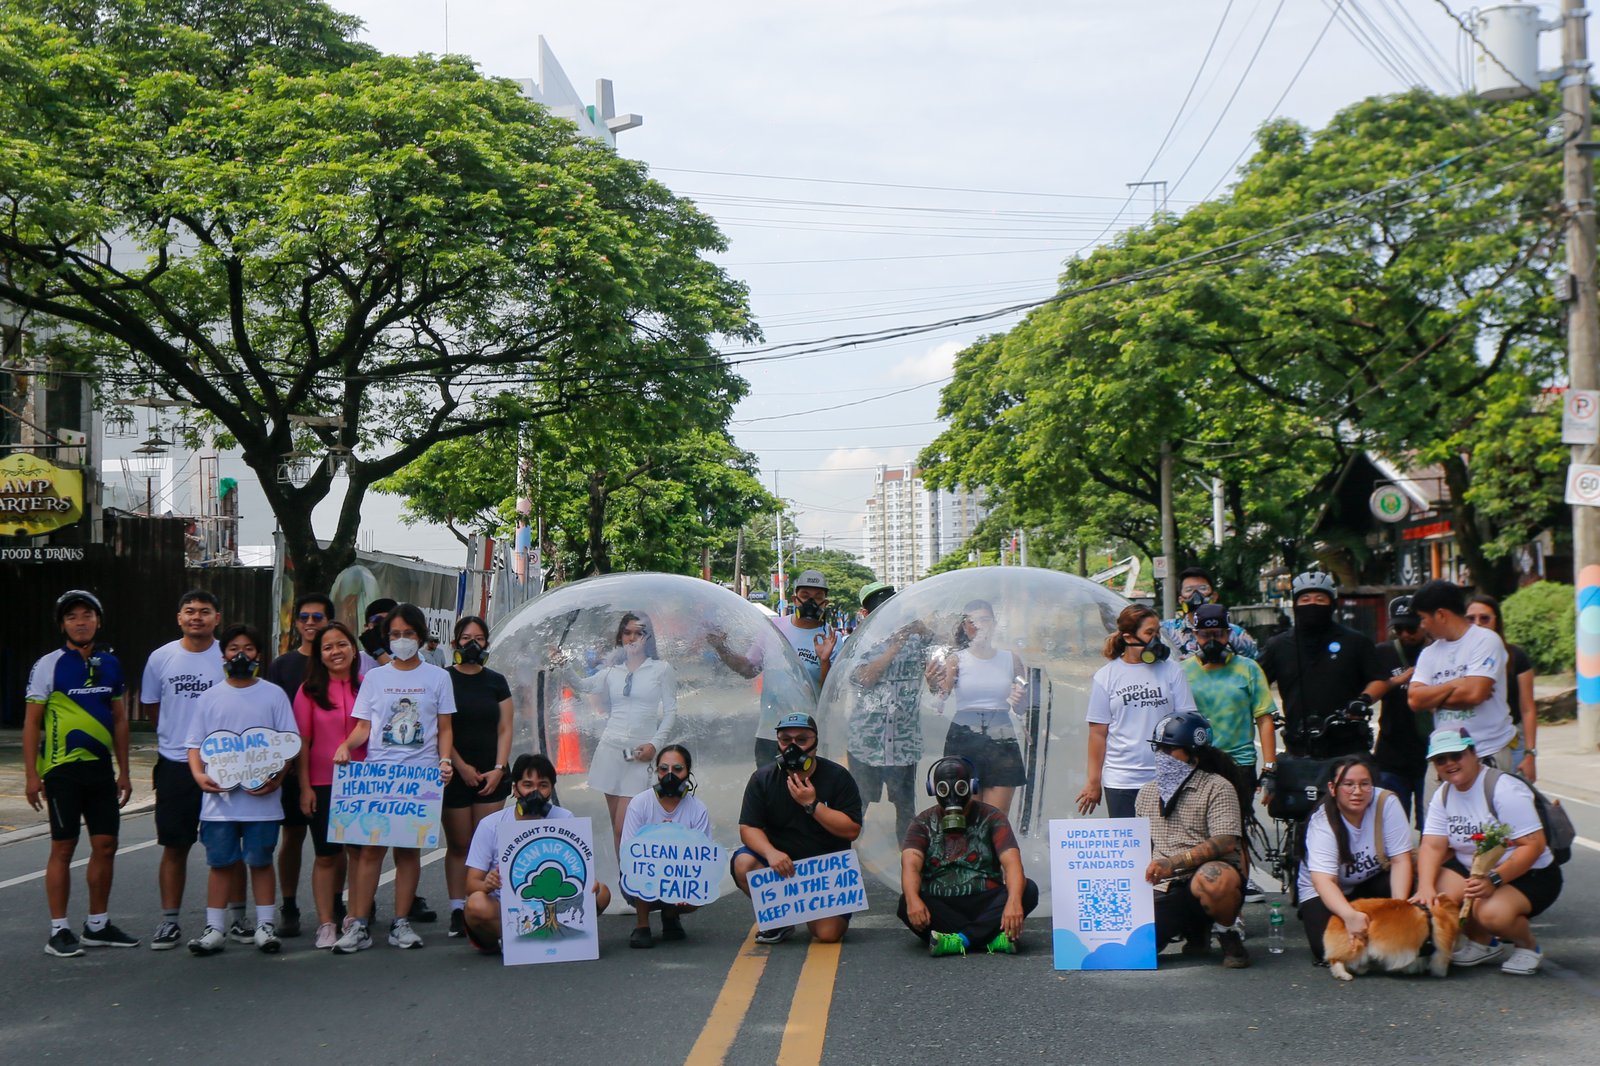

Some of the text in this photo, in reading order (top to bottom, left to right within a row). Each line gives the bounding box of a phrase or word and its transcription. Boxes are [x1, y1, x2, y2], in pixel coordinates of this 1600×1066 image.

[1580, 477, 1599, 491] 60
[1, 548, 84, 560] FOOD & DRINKS
[799, 651, 818, 662] pedal
[168, 674, 198, 684] happy
[175, 680, 213, 694] pedal
[1116, 684, 1145, 696] happy
[1122, 687, 1162, 705] pedal
[1140, 698, 1168, 708] project
[203, 733, 295, 756] CLEAN AIR is a
[245, 748, 269, 763] Not
[338, 762, 387, 779] STRONG
[343, 780, 420, 795] HEALTHY AIR
[335, 799, 428, 817] JUST FUTURE
[1067, 829, 1133, 839] UPDATE THE
[501, 844, 515, 863] OUR
[514, 826, 540, 844] RIGHT
[558, 827, 593, 861] BREATHE,
[1061, 839, 1140, 849] PHILIPPINE AIR
[630, 843, 718, 861] CLEAN AIR!
[1077, 850, 1125, 859] QUALITY
[512, 844, 542, 879] CLEAN
[542, 842, 563, 855] AIR
[1068, 860, 1135, 870] STANDARDS
[663, 864, 702, 878] ONLY
[750, 853, 851, 888] OUR FUTURE
[659, 879, 708, 900] FAIR!
[761, 869, 859, 905] IS IN THE AIR
[757, 888, 864, 924] KEEP IT CLEAN!
